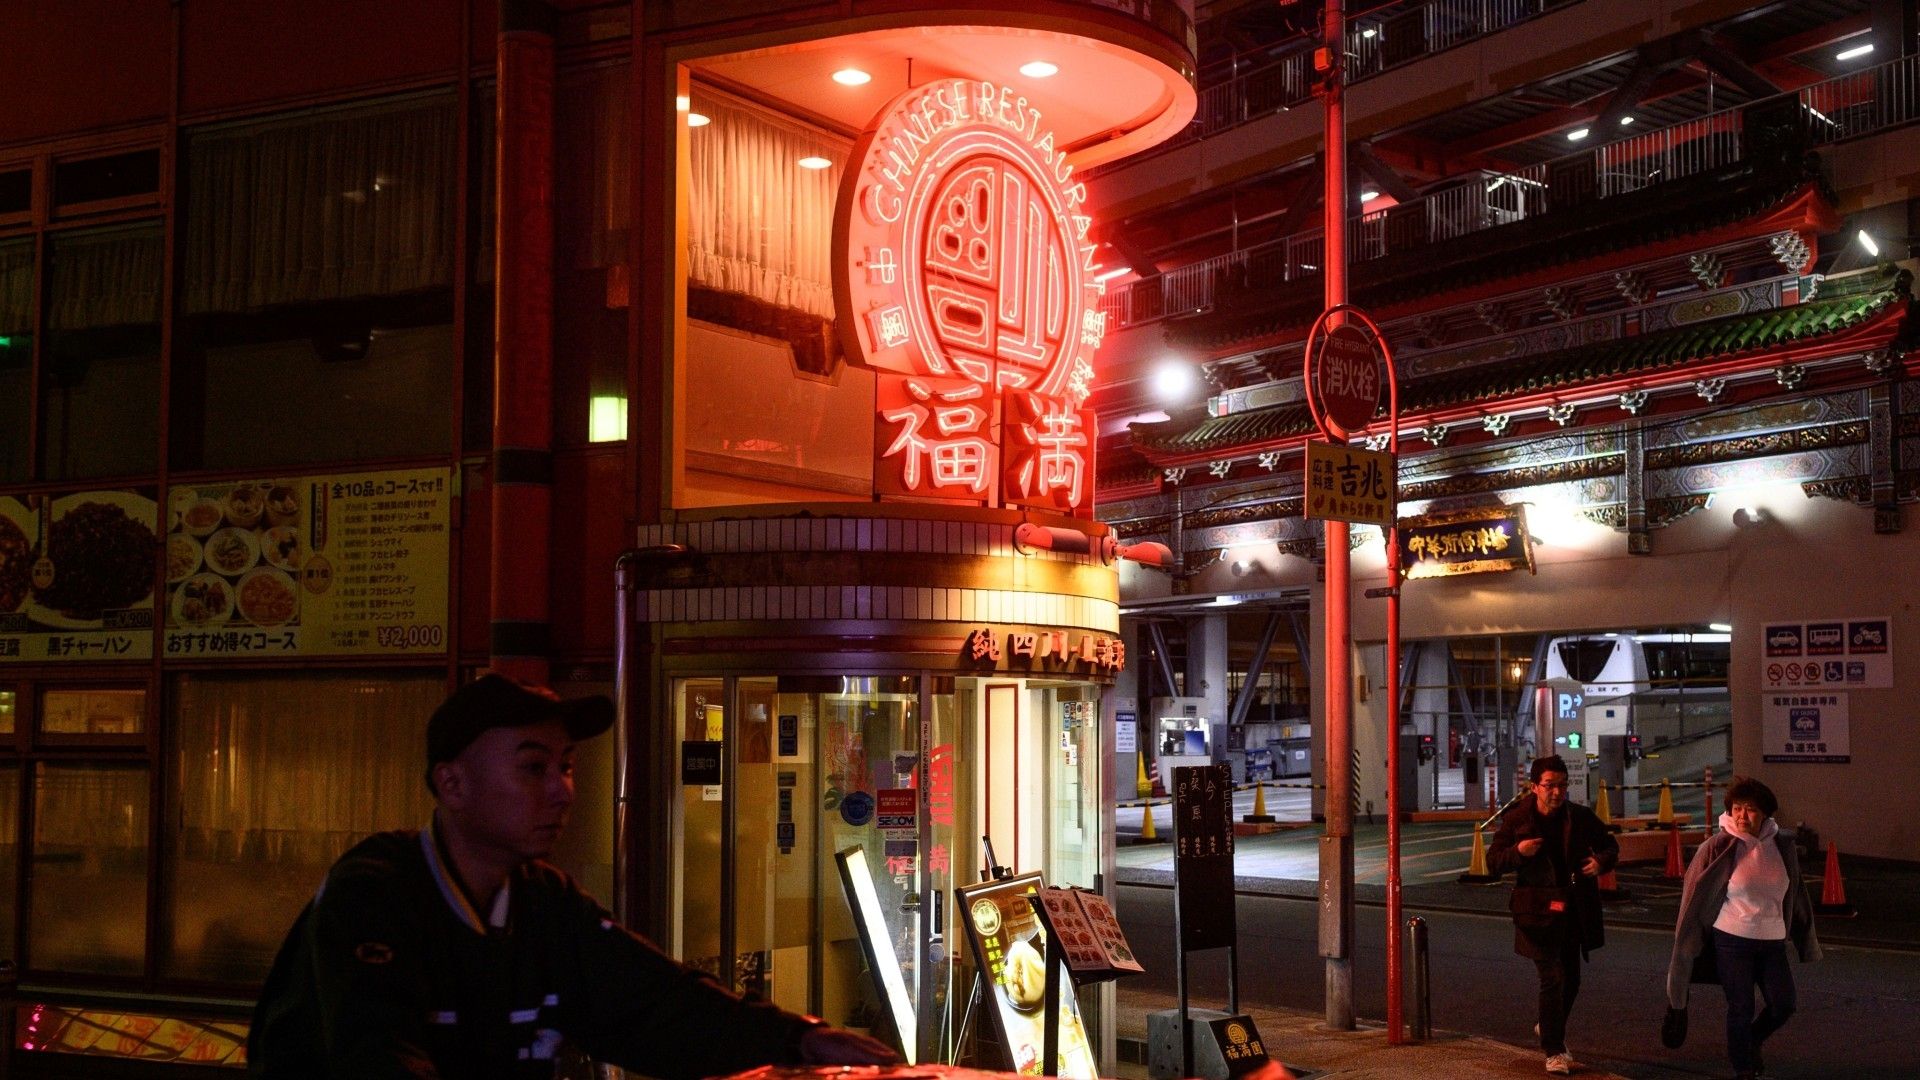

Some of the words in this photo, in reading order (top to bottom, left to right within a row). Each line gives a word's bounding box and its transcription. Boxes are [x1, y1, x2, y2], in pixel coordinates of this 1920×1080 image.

[874, 81, 968, 222] CHINESE
[980, 81, 1106, 295] RESTAURANT
[1325, 354, 1376, 402] 消火栓
[1337, 453, 1388, 501] 吉兆
[48, 636, 132, 657] 黒チャーハン
[167, 632, 297, 652] おすすめ得々コース
[377, 625, 442, 649] ¥2,000
[1559, 693, 1573, 718] P
[878, 816, 914, 826] SECOM
